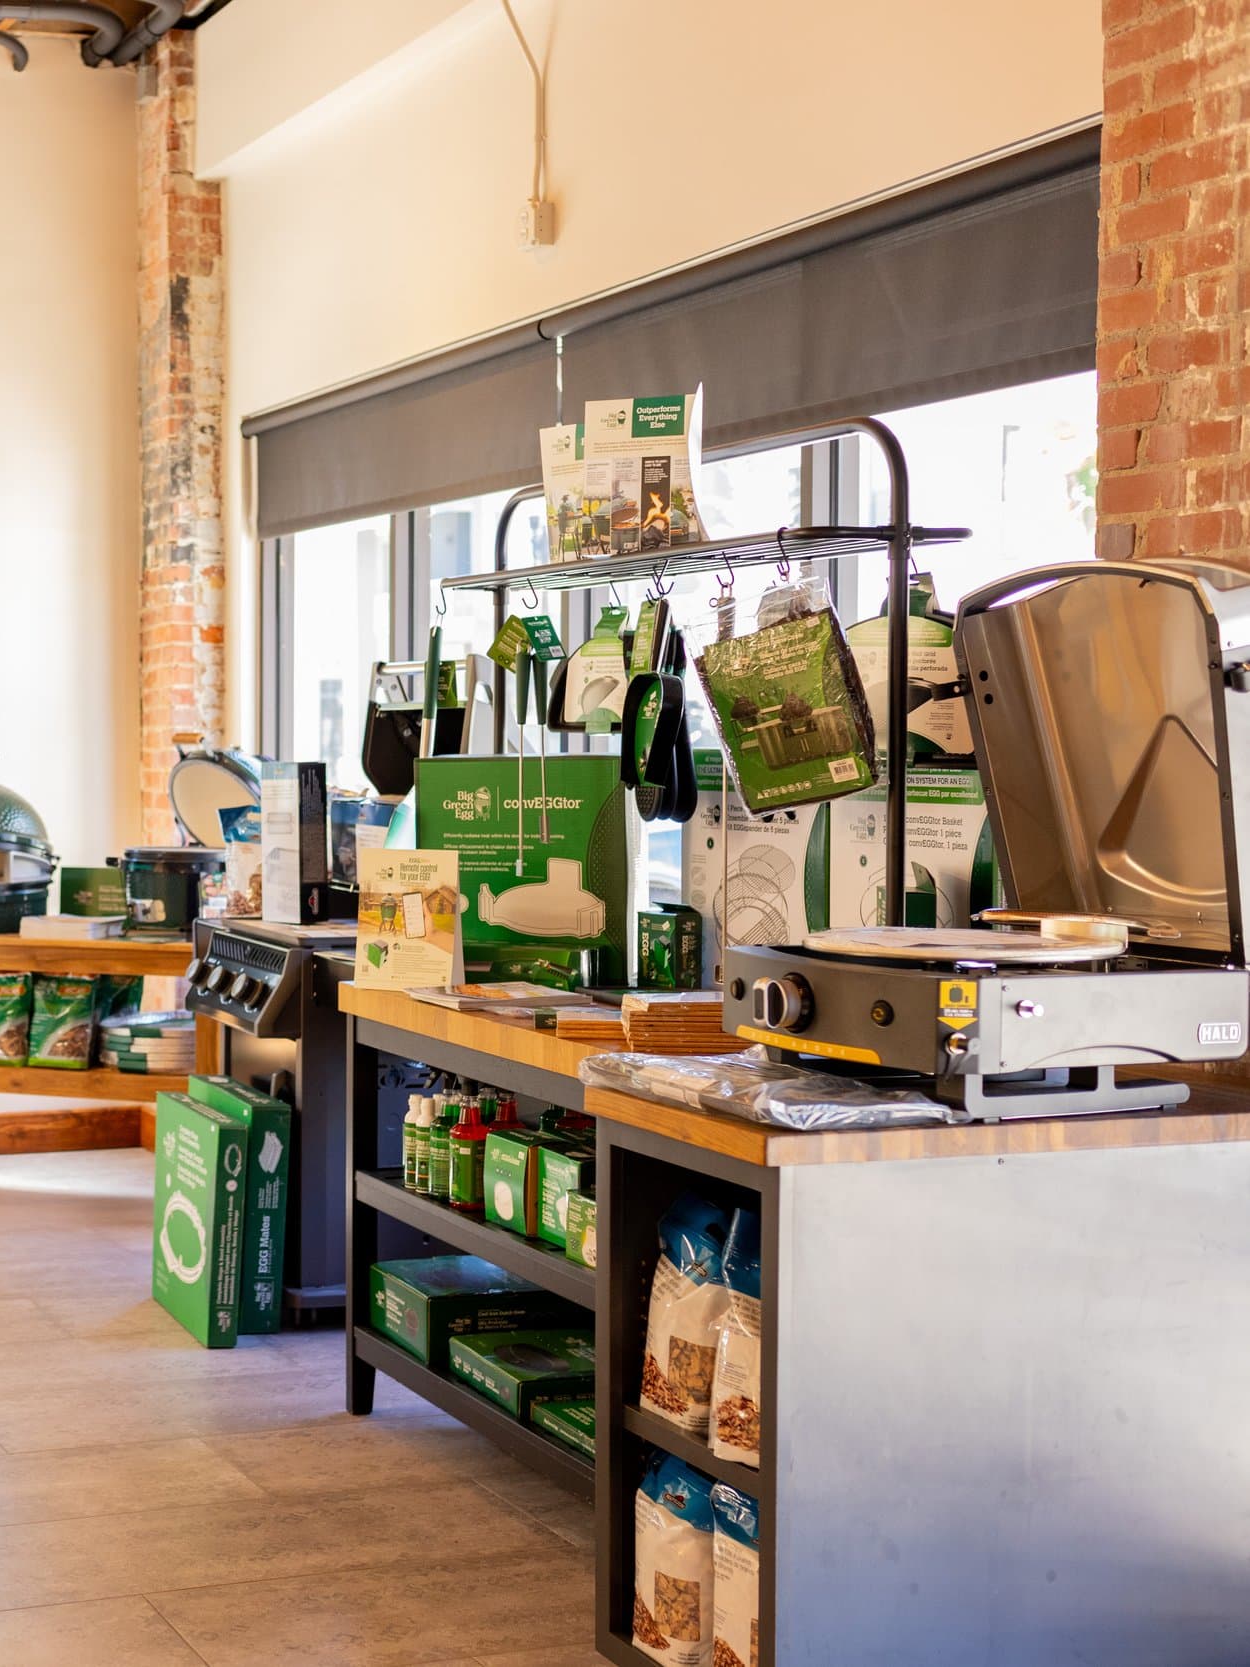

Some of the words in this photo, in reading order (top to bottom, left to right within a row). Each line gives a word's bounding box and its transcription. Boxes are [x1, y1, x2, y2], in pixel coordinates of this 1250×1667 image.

[636, 405, 681, 415] Outperforms
[638, 413, 678, 423] Everything
[649, 421, 666, 429] Else
[915, 776, 937, 785] SYSTEM
[937, 777, 949, 785] FOR
[949, 777, 958, 785] AN
[456, 790, 474, 801] Big
[442, 799, 474, 810] Green
[503, 797, 581, 809] convEGGtor
[455, 808, 474, 821] Egg
[905, 816, 941, 825] convEGGtor
[942, 816, 964, 826] Basket
[906, 828, 938, 837] onvEGGtor
[1203, 1026, 1239, 1041] HALO
[260, 1215, 270, 1248] Mates
[258, 1249, 269, 1273] EGG
